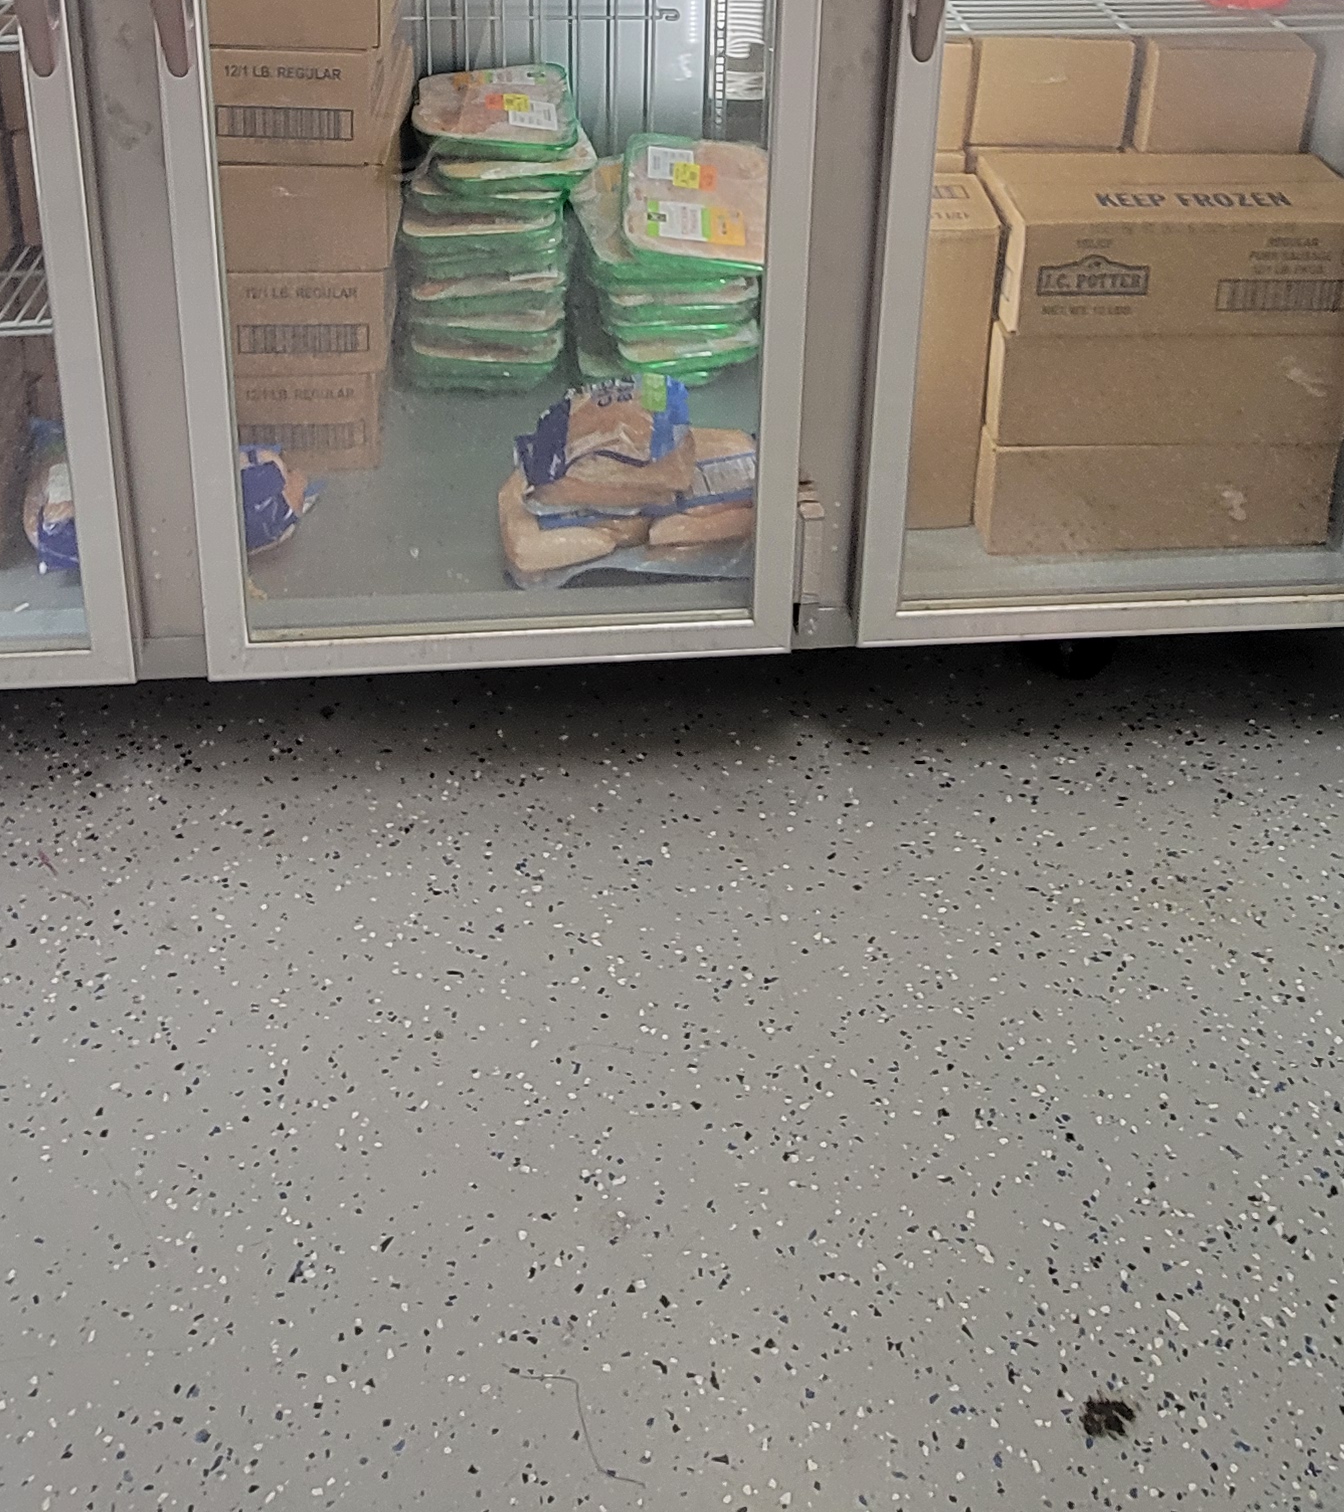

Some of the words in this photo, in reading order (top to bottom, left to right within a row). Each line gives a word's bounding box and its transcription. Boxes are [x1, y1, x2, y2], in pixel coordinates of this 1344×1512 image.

[224, 65, 250, 78] 12/1
[277, 66, 342, 81] REGULAR
[1094, 191, 1166, 208] KEEP
[1174, 191, 1294, 208] FROZEN
[1076, 272, 1142, 289] POTTER
